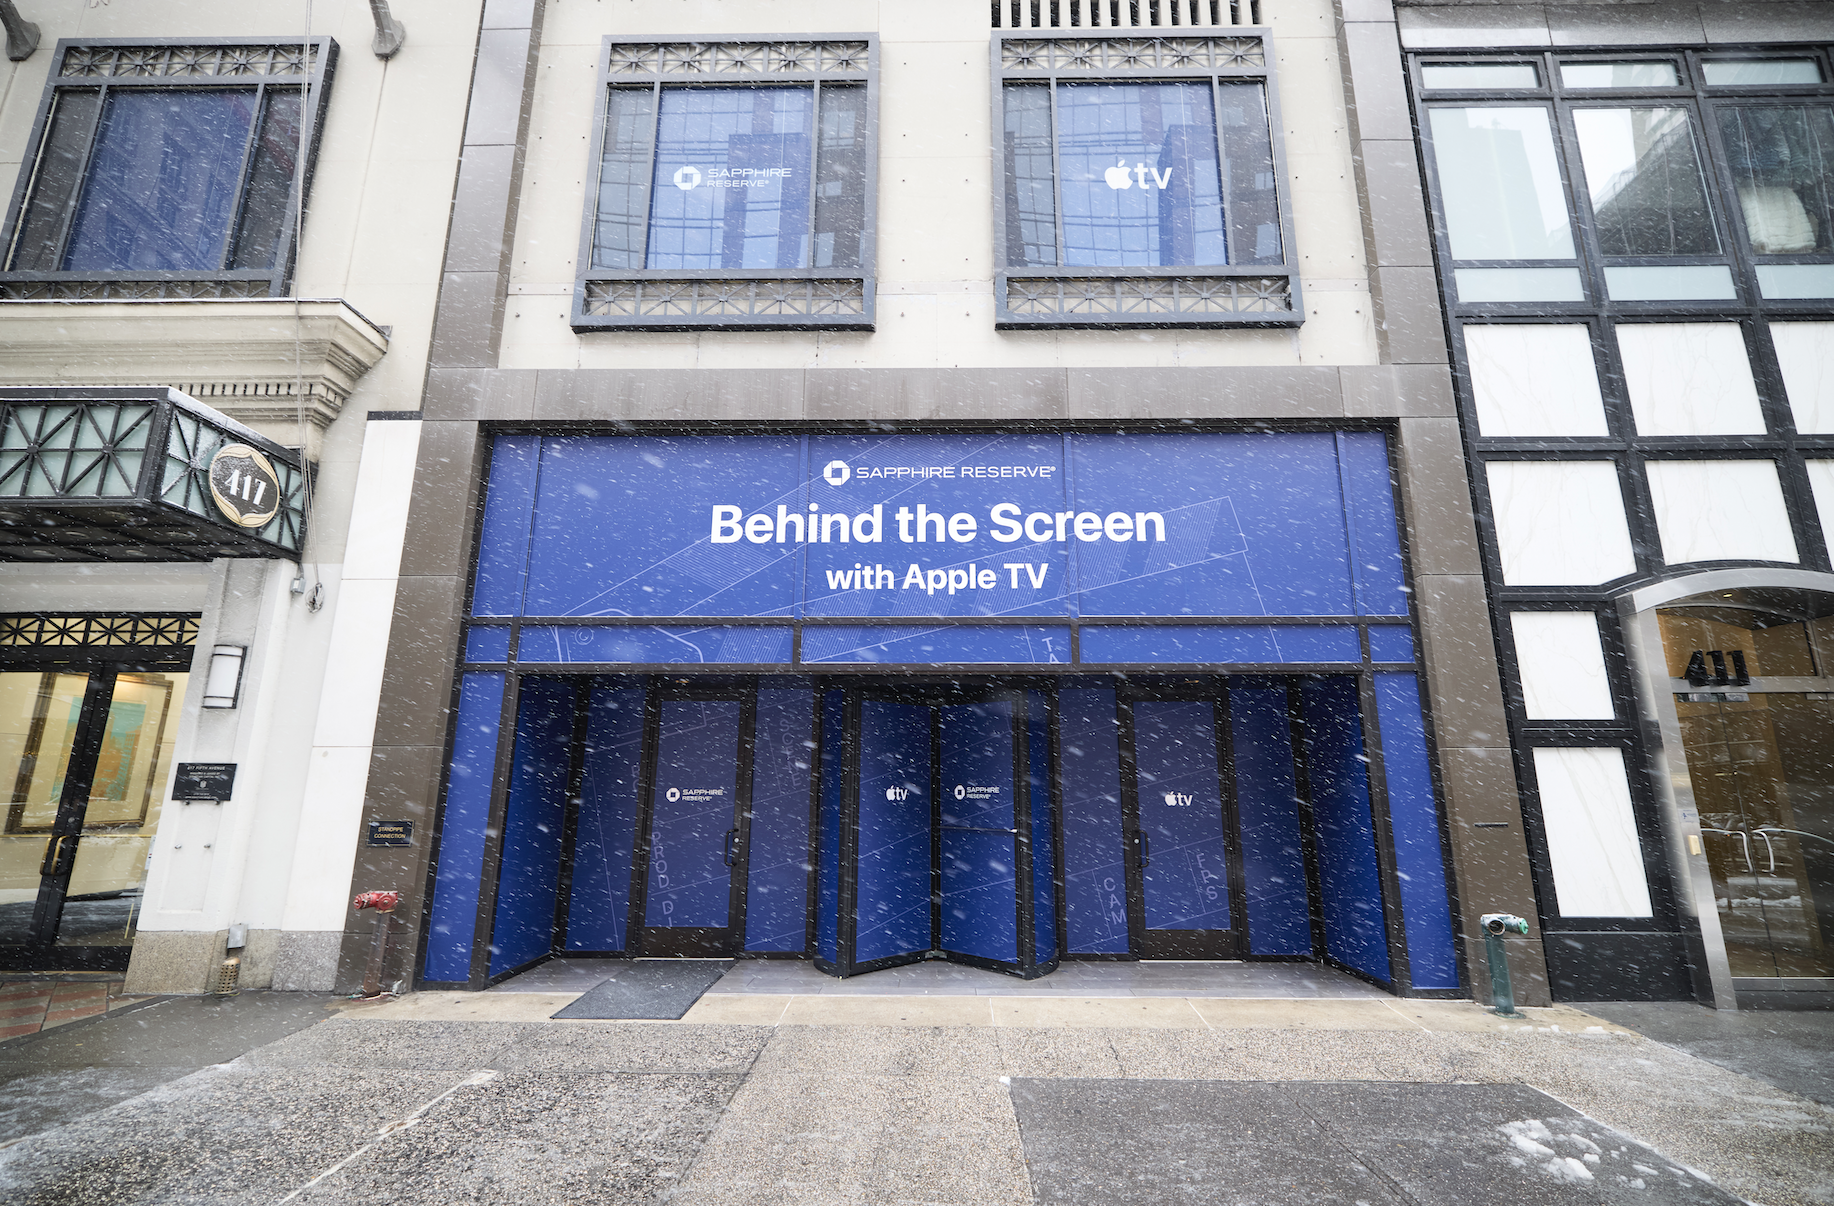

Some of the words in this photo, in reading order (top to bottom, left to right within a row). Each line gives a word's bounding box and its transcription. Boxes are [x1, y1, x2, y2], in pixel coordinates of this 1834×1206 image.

[707, 168, 792, 178] SAPPHIRE
[1133, 162, 1173, 190] tv
[856, 466, 956, 478] SAPPHIRE
[224, 469, 267, 506] 417
[710, 502, 883, 544] Behind
[895, 503, 977, 543] the
[989, 502, 1166, 543] Screen
[825, 563, 895, 590] with
[902, 563, 997, 595] Apple
[1003, 562, 1049, 589] TV
[1683, 650, 1751, 687] 411
[895, 786, 908, 801] tv
[966, 786, 1000, 794] SAPPHIRE
[1177, 792, 1193, 807] tv
[1196, 852, 1218, 900] FPS
[1103, 877, 1127, 925] CAM
